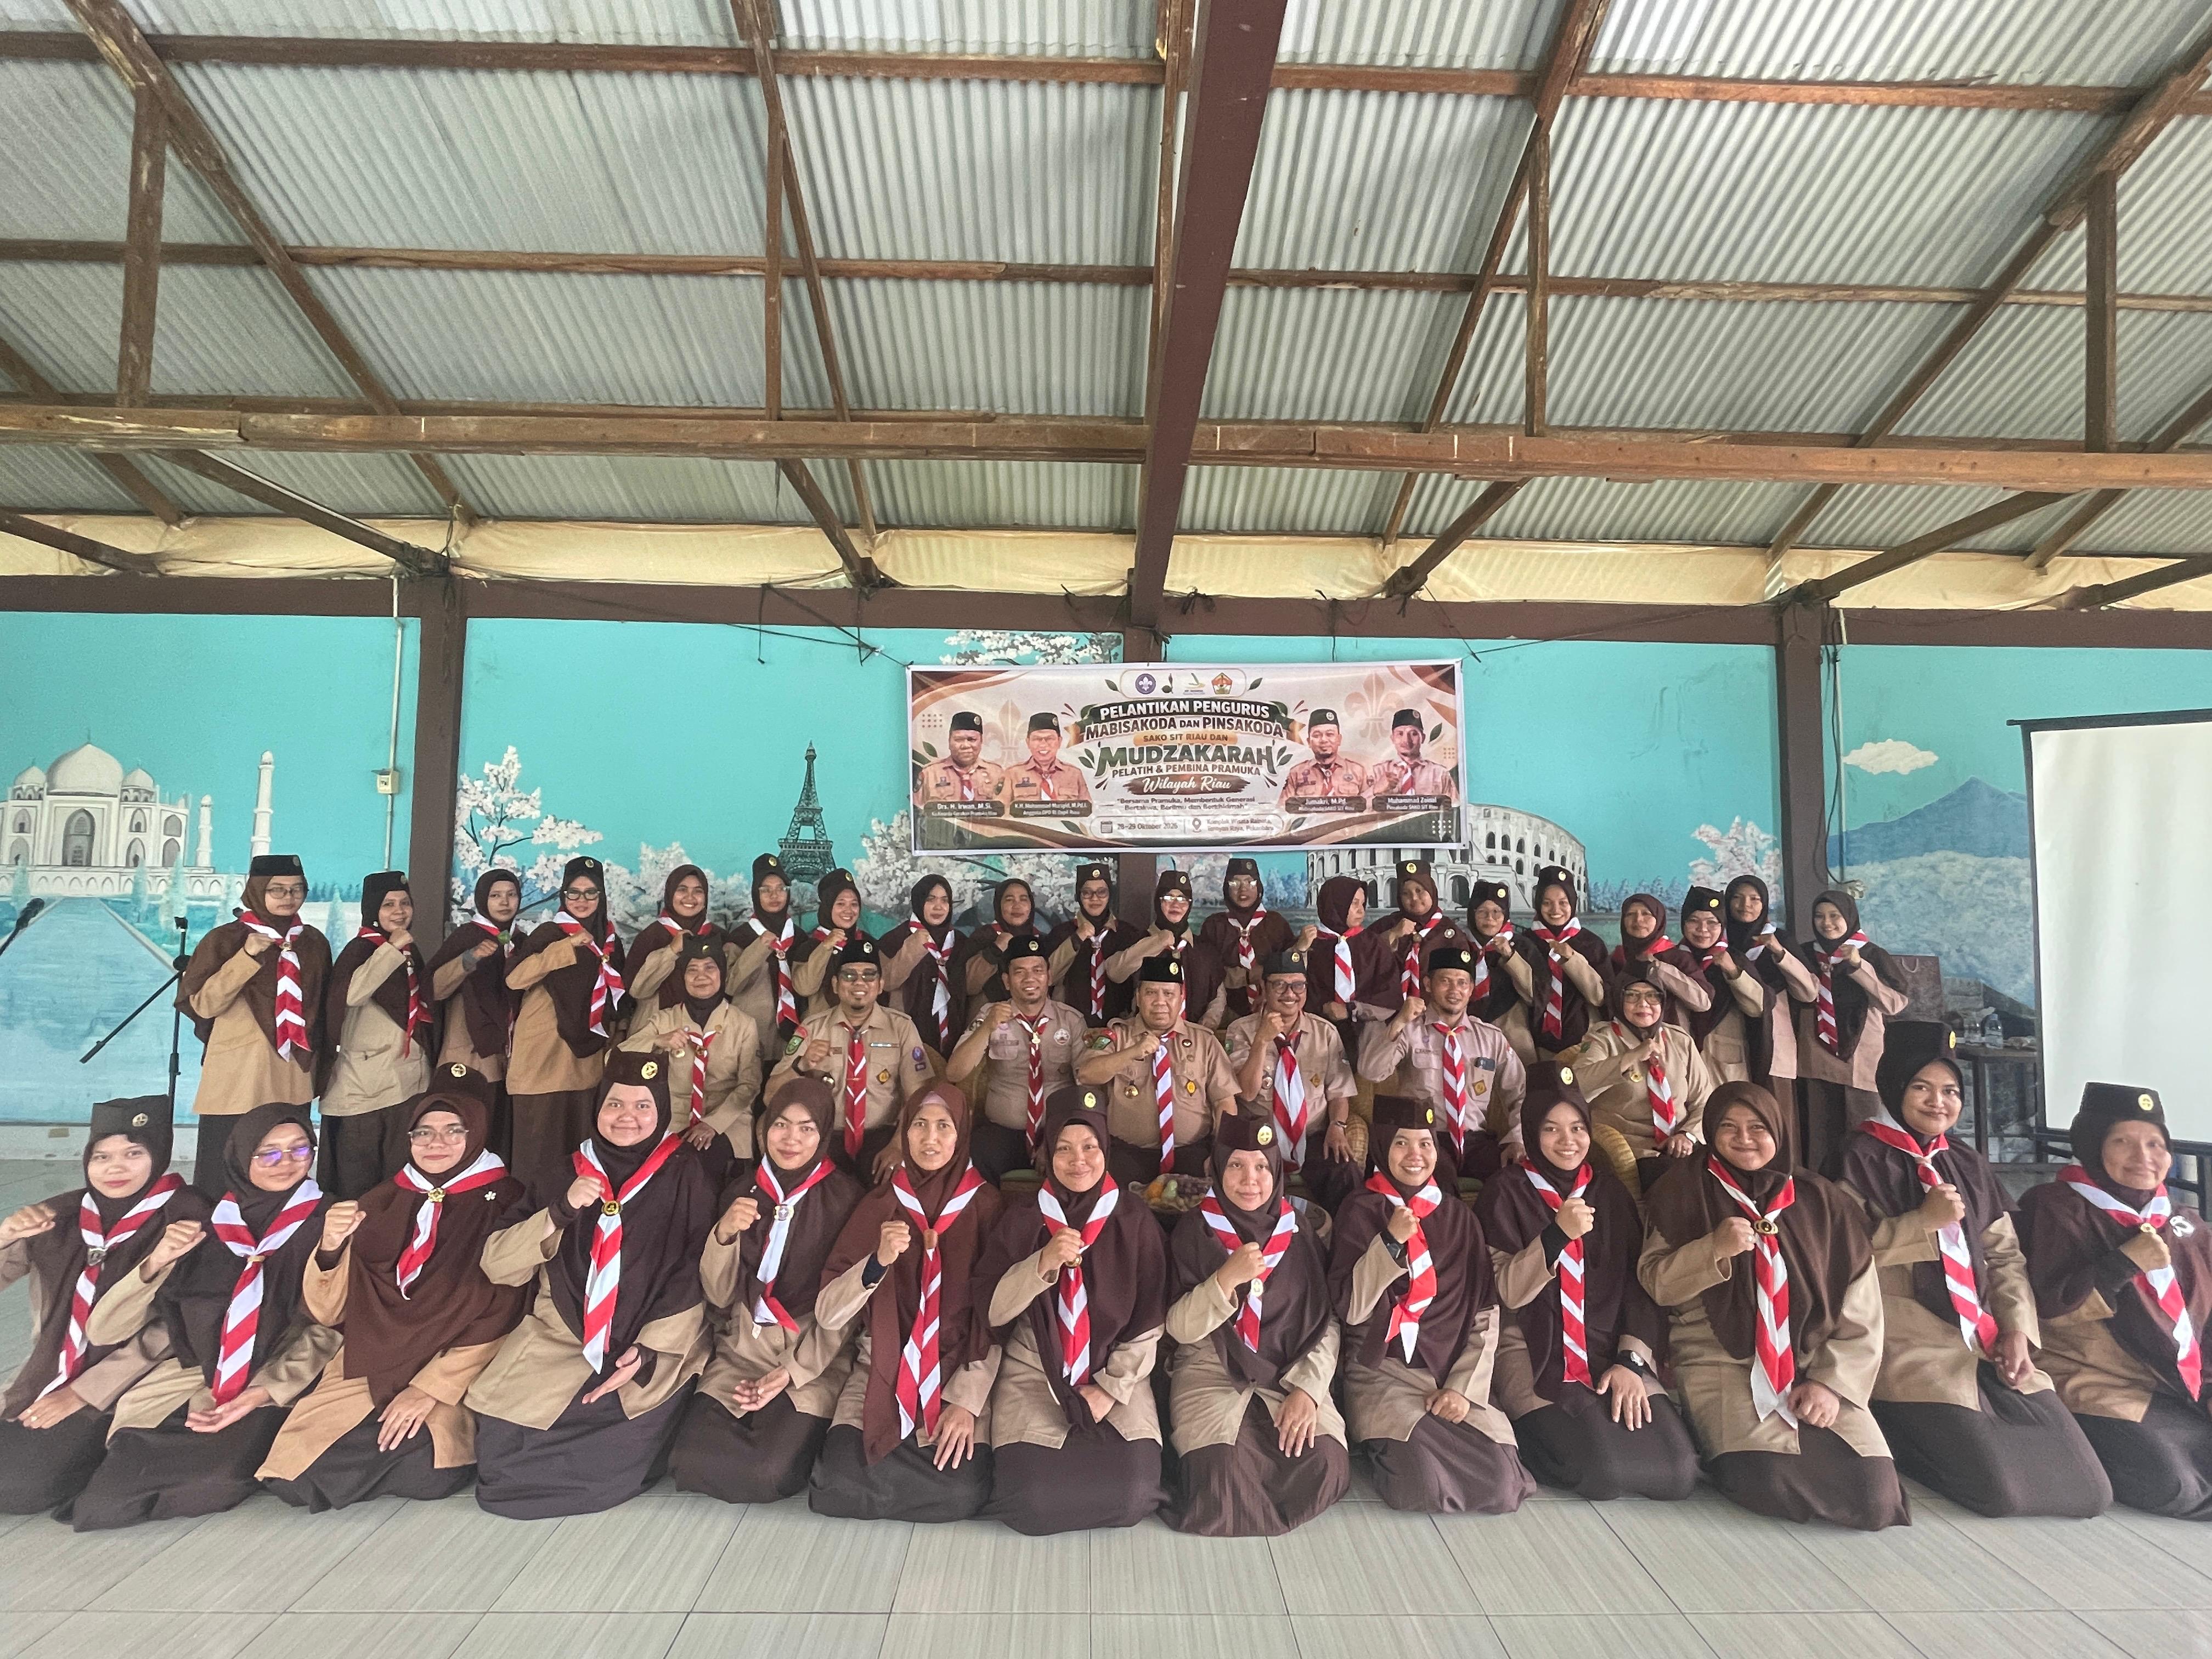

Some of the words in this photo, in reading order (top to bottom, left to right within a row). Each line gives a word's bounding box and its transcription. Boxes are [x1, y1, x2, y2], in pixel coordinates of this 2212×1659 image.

[1099, 700, 1189, 721] PELANTIKAN
[1193, 699, 1269, 719] PENGURUS
[1085, 717, 1177, 741] MABISAKODA
[1180, 719, 1200, 729] DAN
[1202, 716, 1284, 738] PINSAKODA
[1094, 744, 1278, 777] MUDZAKARAH
[1112, 766, 1153, 778] PELATIH
[1155, 765, 1164, 773] &
[1165, 764, 1209, 773] PEMBINA
[1211, 764, 1261, 776] PRAMUKA
[1142, 776, 1196, 794] Wilayah
[1200, 776, 1232, 789] Riau
